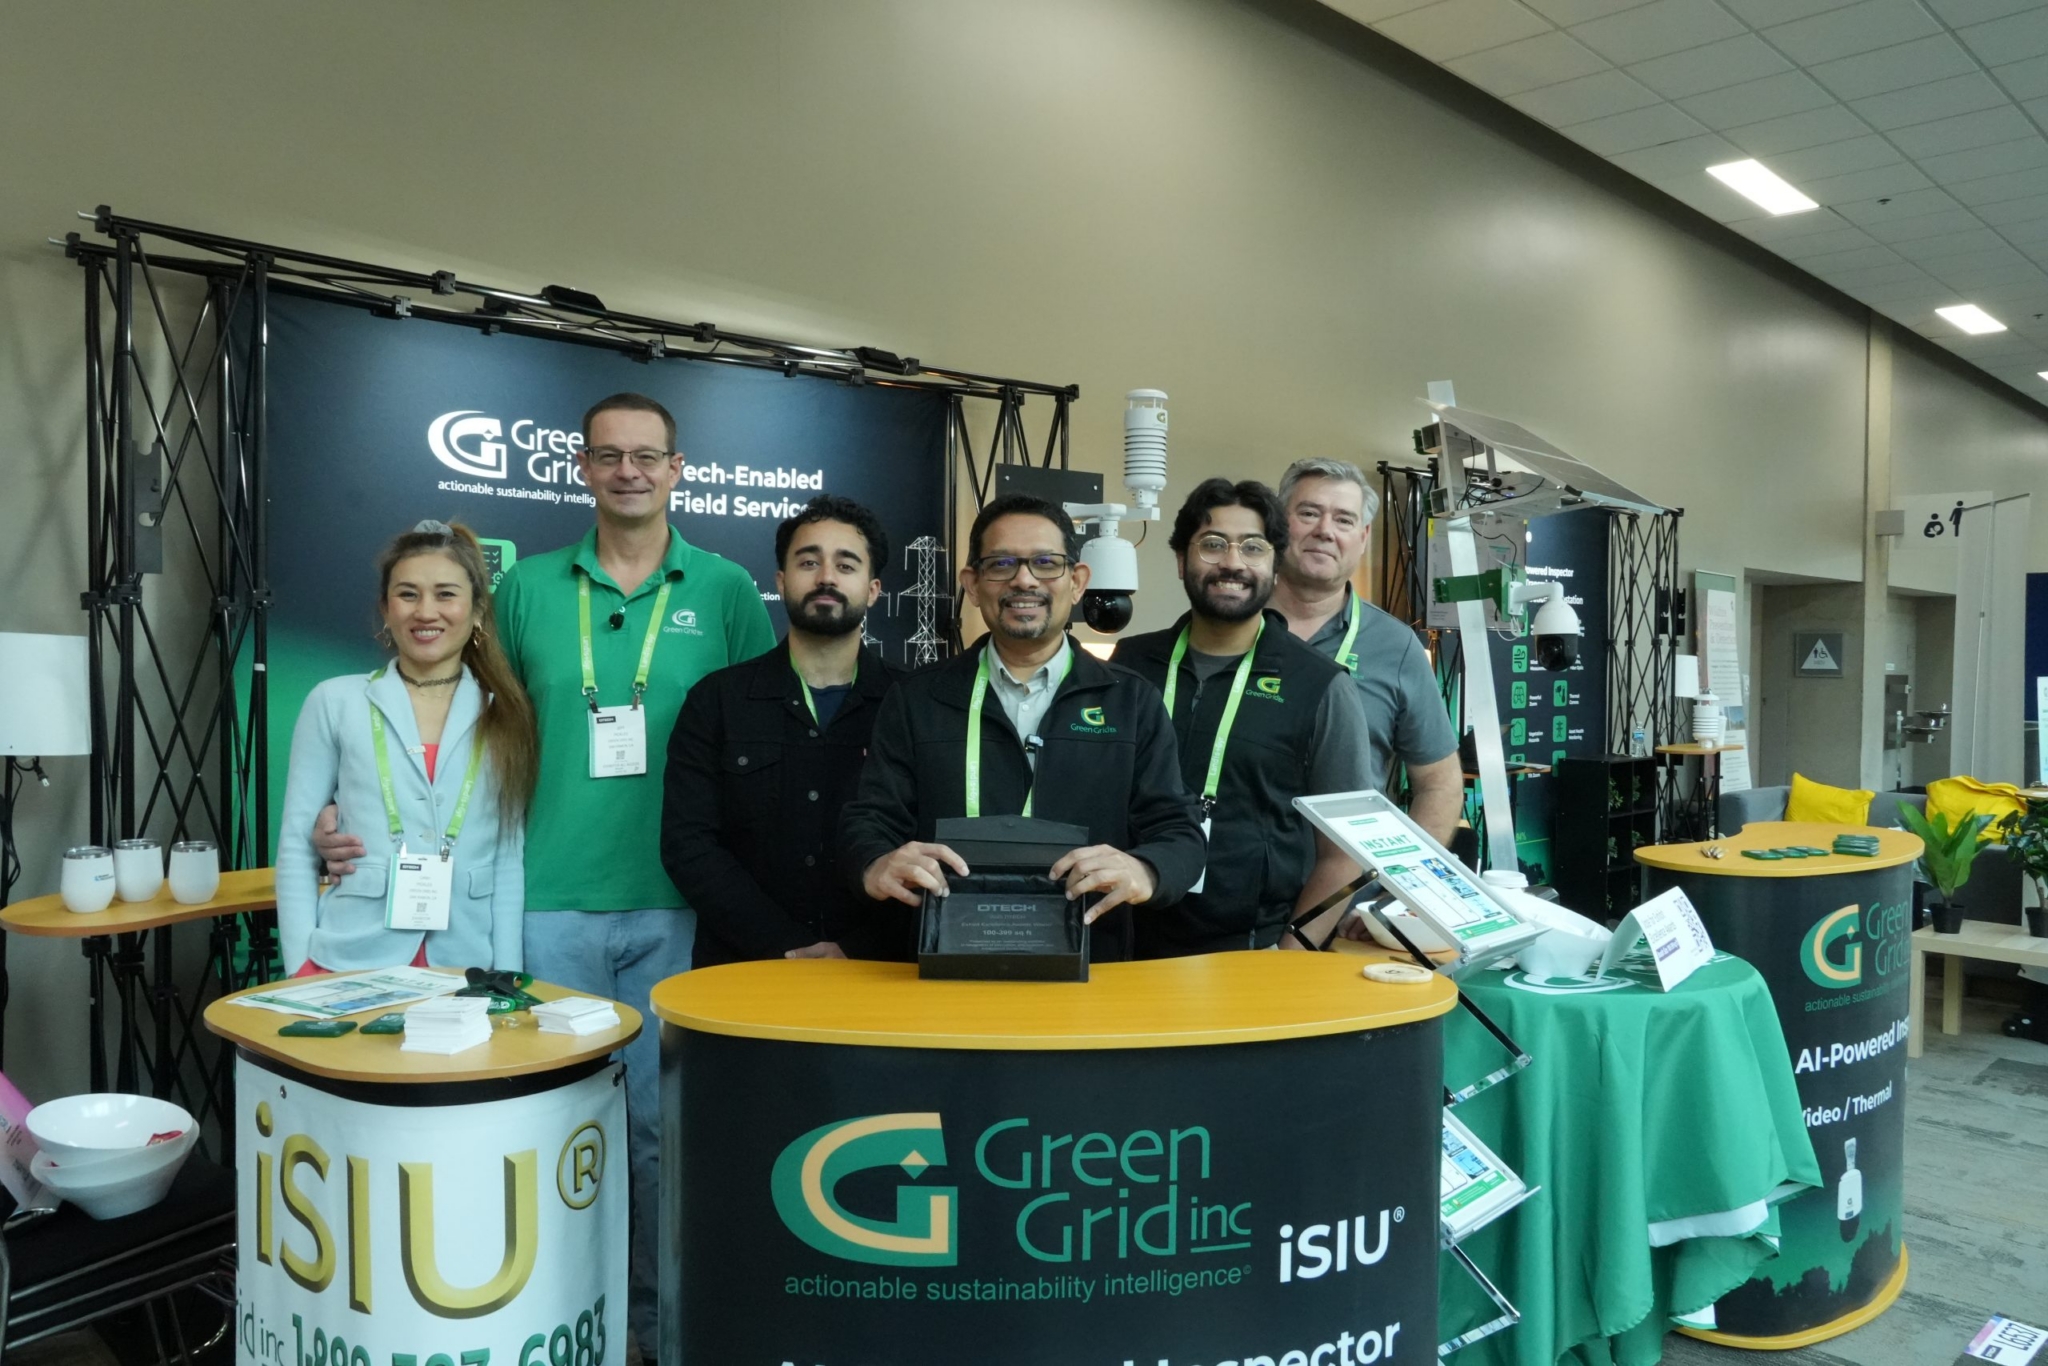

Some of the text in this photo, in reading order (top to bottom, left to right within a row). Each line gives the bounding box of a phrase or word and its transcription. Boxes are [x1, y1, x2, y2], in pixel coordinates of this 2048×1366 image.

[511, 419, 584, 454] Gree
[681, 460, 823, 490] ech-Enabled
[438, 480, 596, 507] actionable sustainability intellig
[670, 490, 808, 518] Field Servic
[1359, 834, 1411, 850] INSTANT
[977, 903, 1037, 912] DTECH
[1805, 993, 1850, 1012] actionable
[1795, 1021, 1895, 1074] AI-Powered
[1852, 1080, 1892, 1115] Thermal
[975, 1117, 1210, 1189] Green
[1016, 1185, 1251, 1262] Grid inc
[785, 1274, 918, 1299] actionable
[926, 1275, 1096, 1303] sustainability
